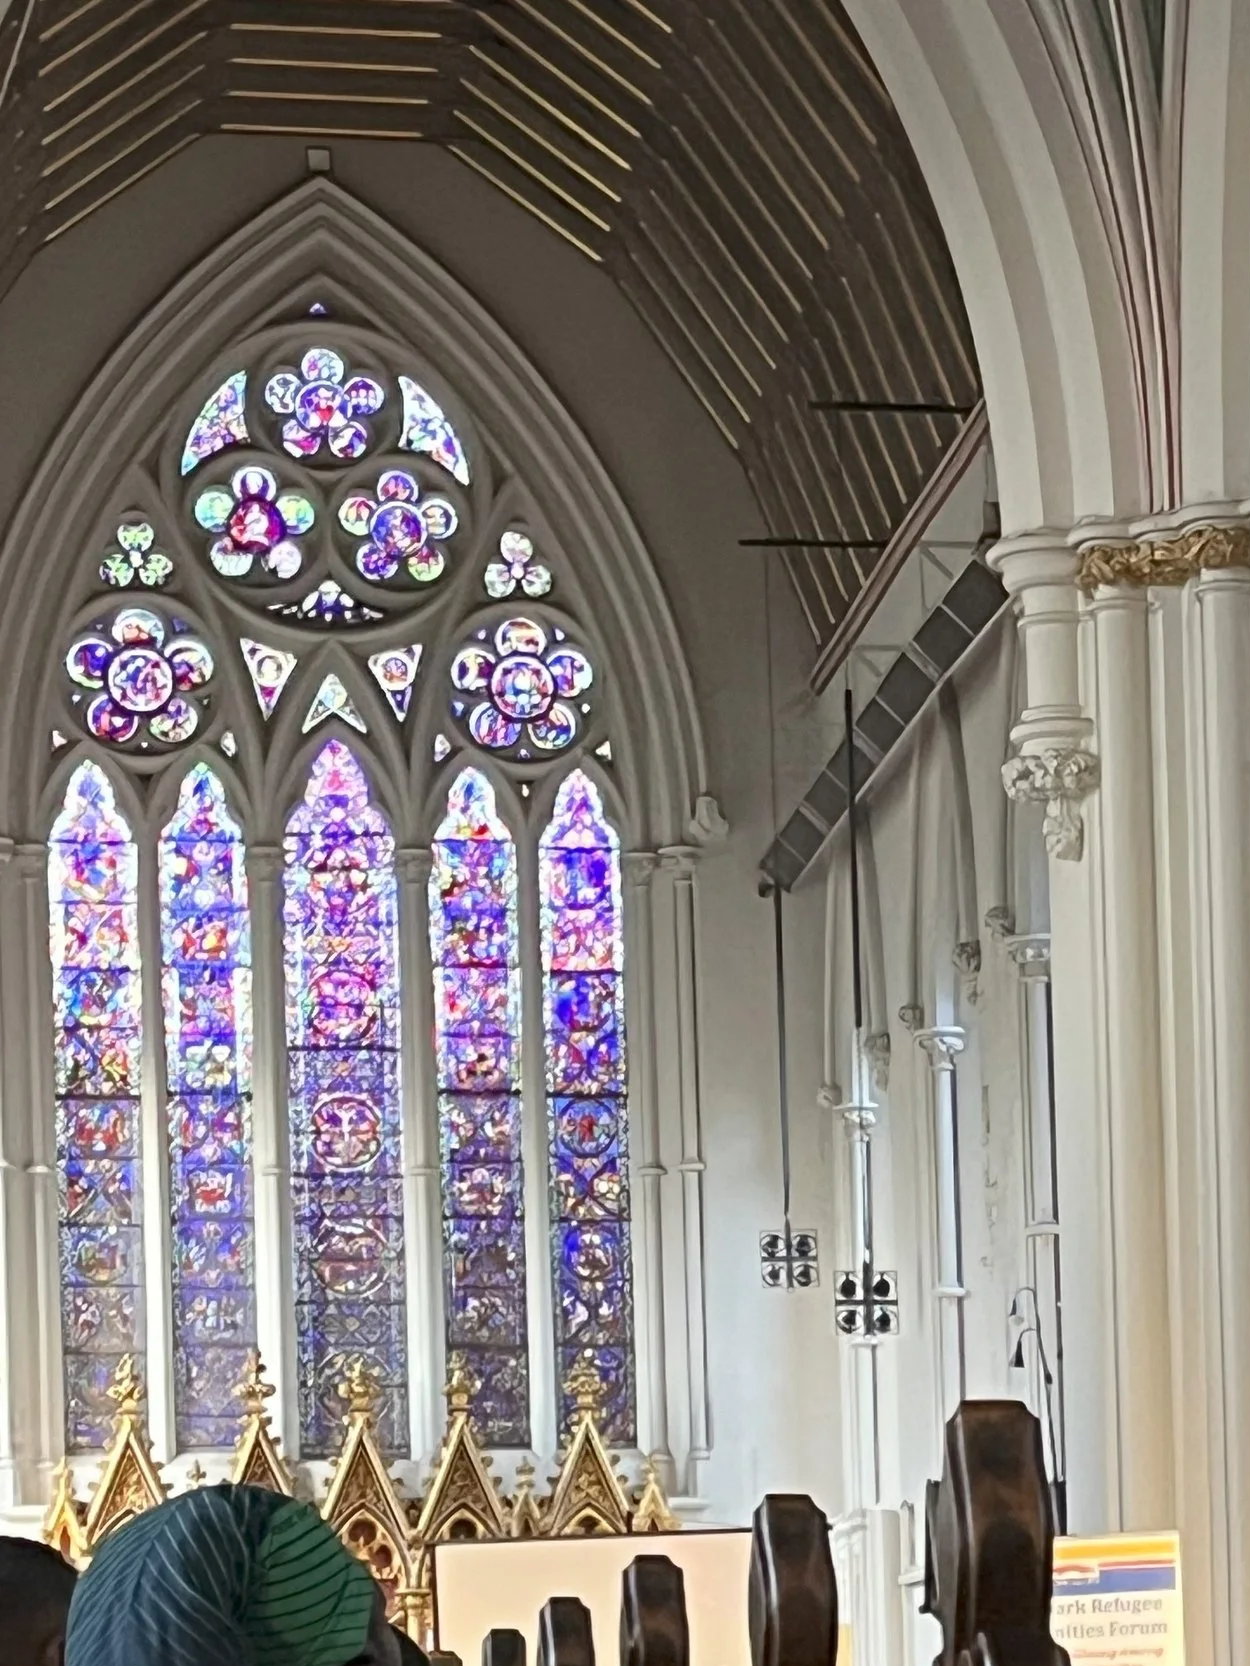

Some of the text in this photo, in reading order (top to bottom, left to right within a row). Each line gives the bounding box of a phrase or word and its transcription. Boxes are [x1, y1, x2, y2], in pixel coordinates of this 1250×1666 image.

[1050, 1597, 1162, 1615] ark Refugee
[1055, 1620, 1168, 1639] nities Forum
